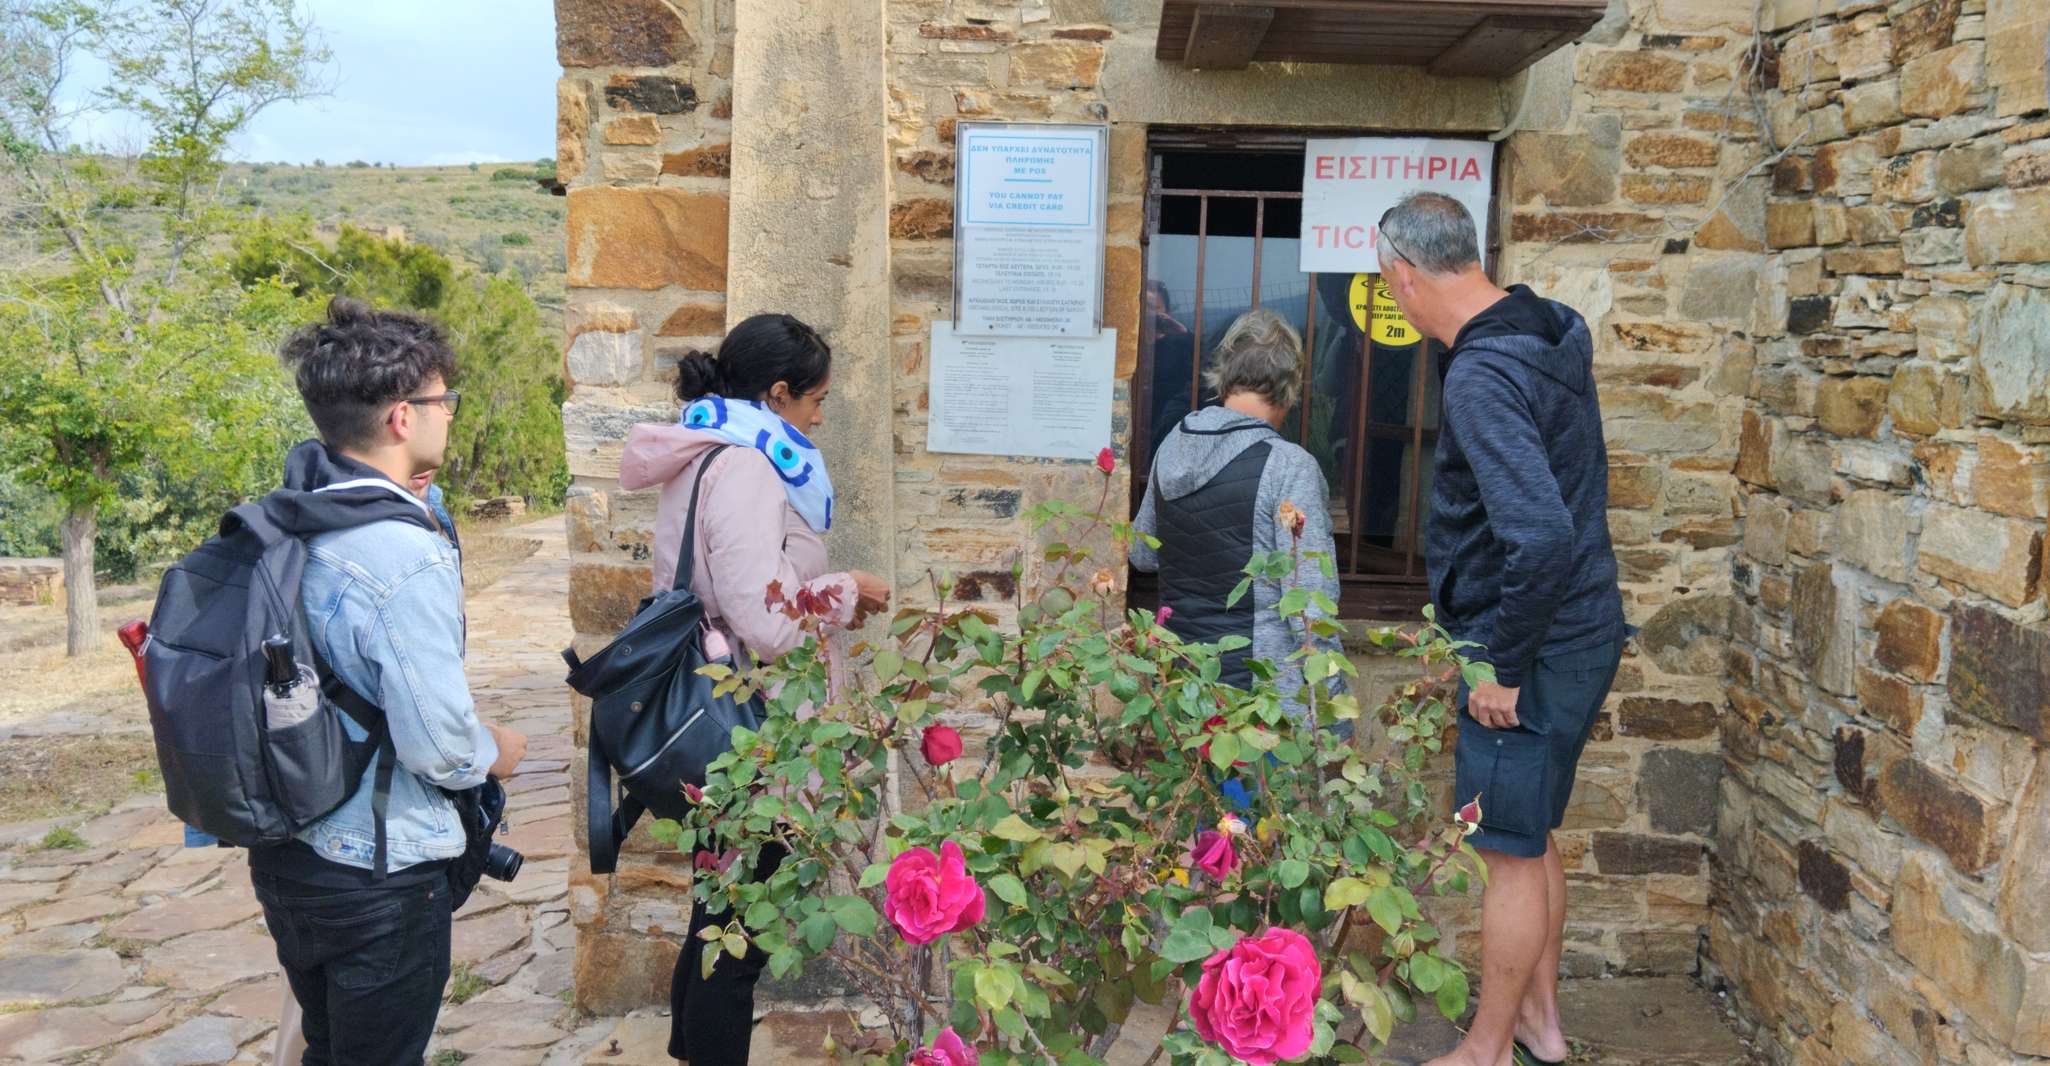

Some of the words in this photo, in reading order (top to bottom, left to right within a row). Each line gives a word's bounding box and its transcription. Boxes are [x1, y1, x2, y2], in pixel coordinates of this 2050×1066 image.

[991, 145, 1029, 153] ΥΠΑΡΧΕΙ
[1032, 146, 1091, 154] ΔΥΝΑΤΟΤΗΤΑ
[1006, 156, 1055, 164] ΠΛΗΡΩΜΗΣ
[1315, 156, 1481, 181] ΕΙΣΙΤΗΡΙΑ
[1009, 192, 1045, 200] CANNOT
[1006, 202, 1037, 210] CREDIT
[1040, 203, 1063, 211] CARD
[1312, 225, 1376, 249] TIC
[1386, 325, 1405, 338] 2m
